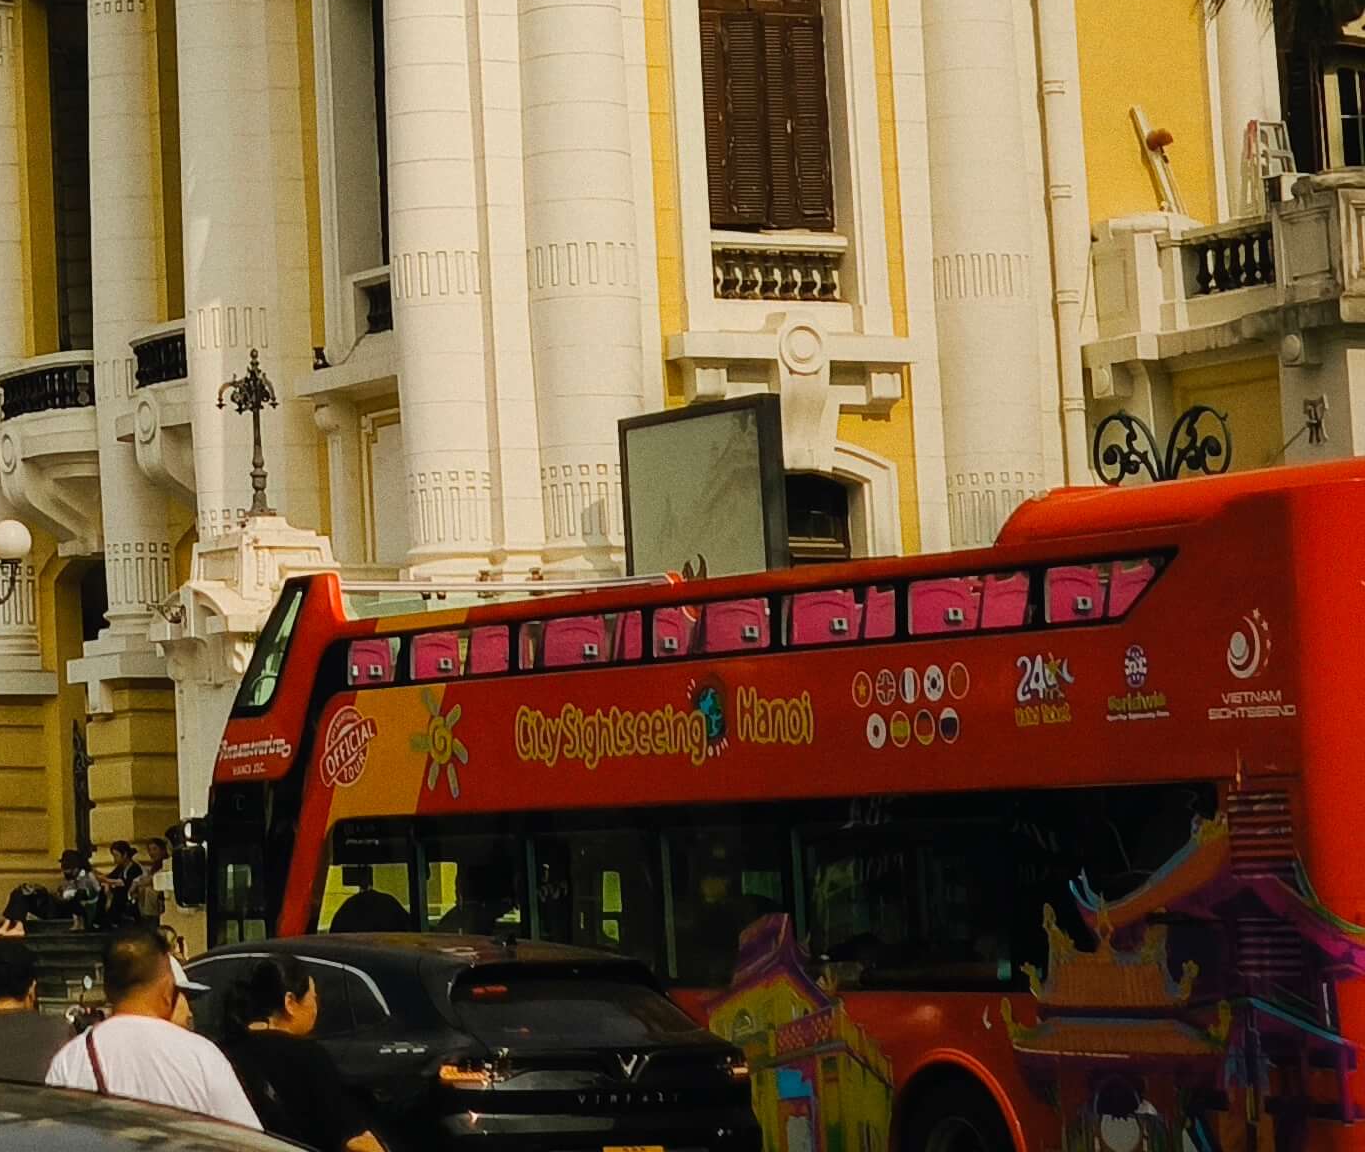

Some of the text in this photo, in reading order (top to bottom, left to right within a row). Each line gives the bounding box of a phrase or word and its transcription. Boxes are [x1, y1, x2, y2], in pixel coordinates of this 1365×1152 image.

[736, 686, 813, 744] Hanoi
[1221, 690, 1283, 705] VIETNAM
[325, 719, 376, 777] OFFICIAL
[343, 751, 367, 781] TOUR
